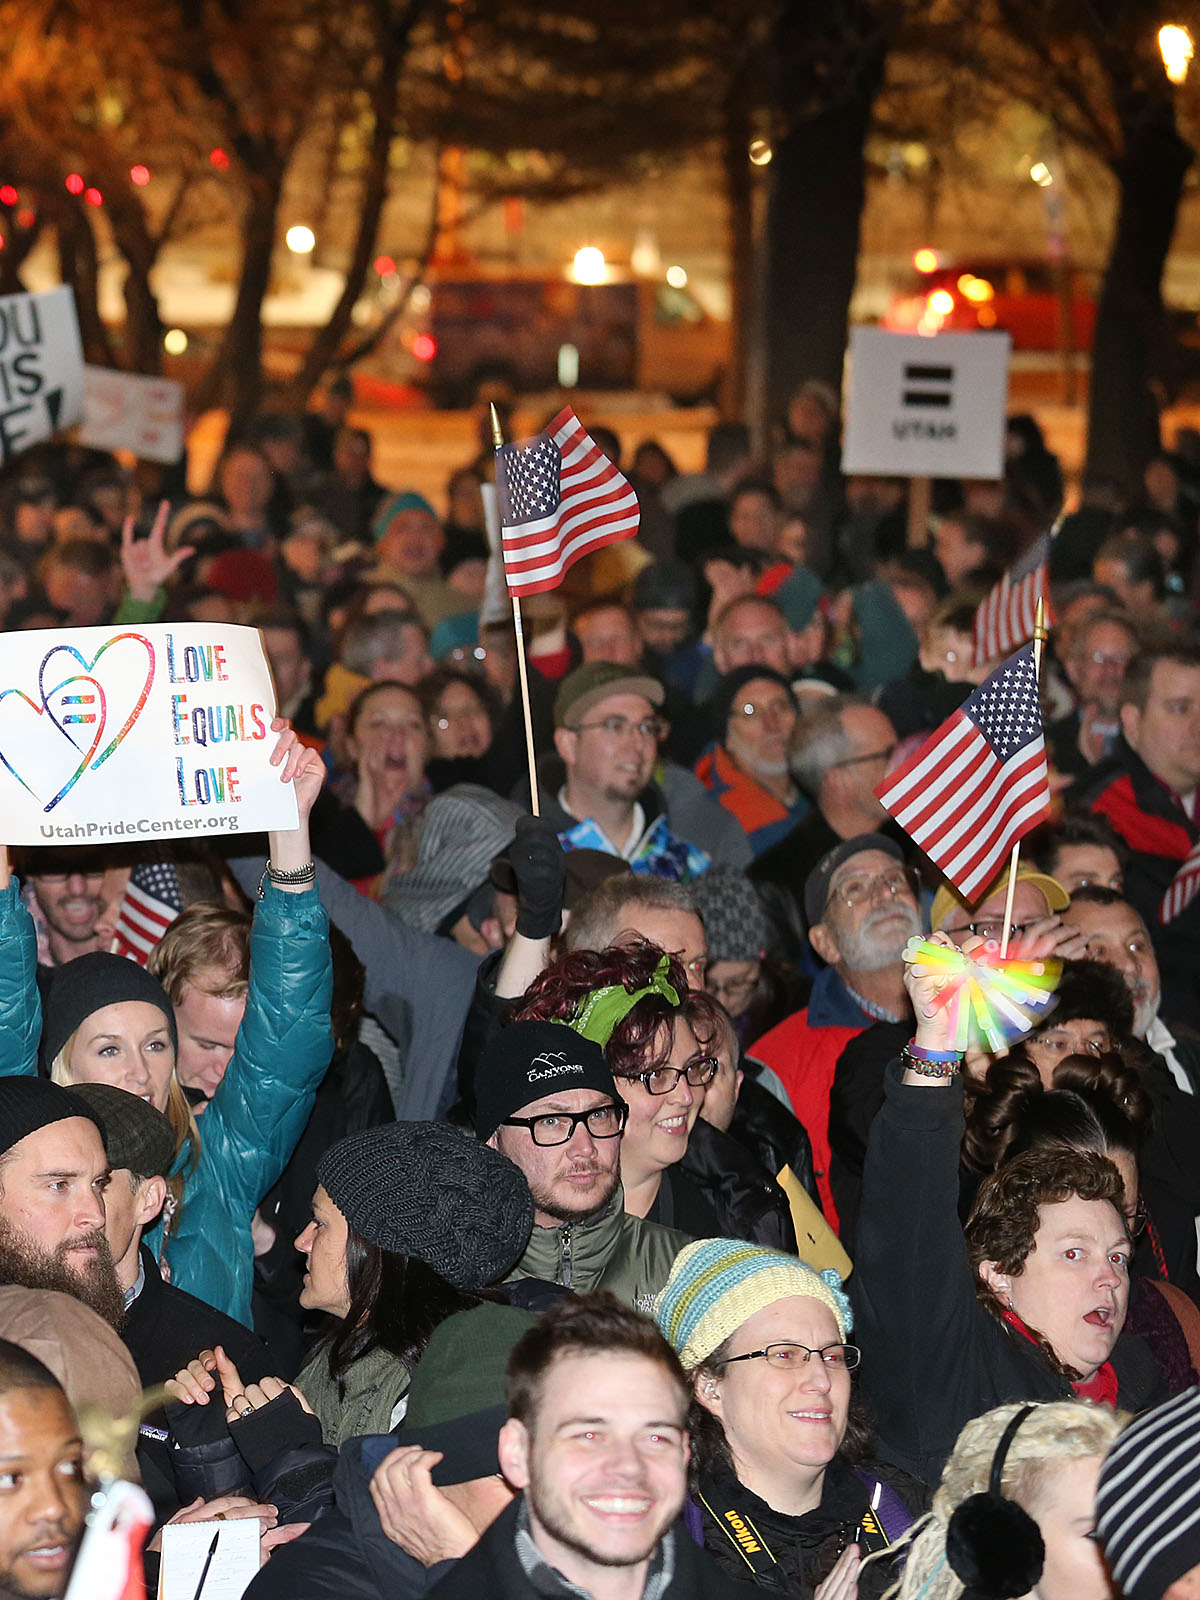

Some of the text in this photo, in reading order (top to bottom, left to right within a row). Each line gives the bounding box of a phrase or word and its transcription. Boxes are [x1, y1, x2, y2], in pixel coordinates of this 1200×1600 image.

[171, 694, 267, 748] EQUALS
[39, 815, 240, 839] UtahPrideCenter.org
[723, 1509, 762, 1554] Nikon
